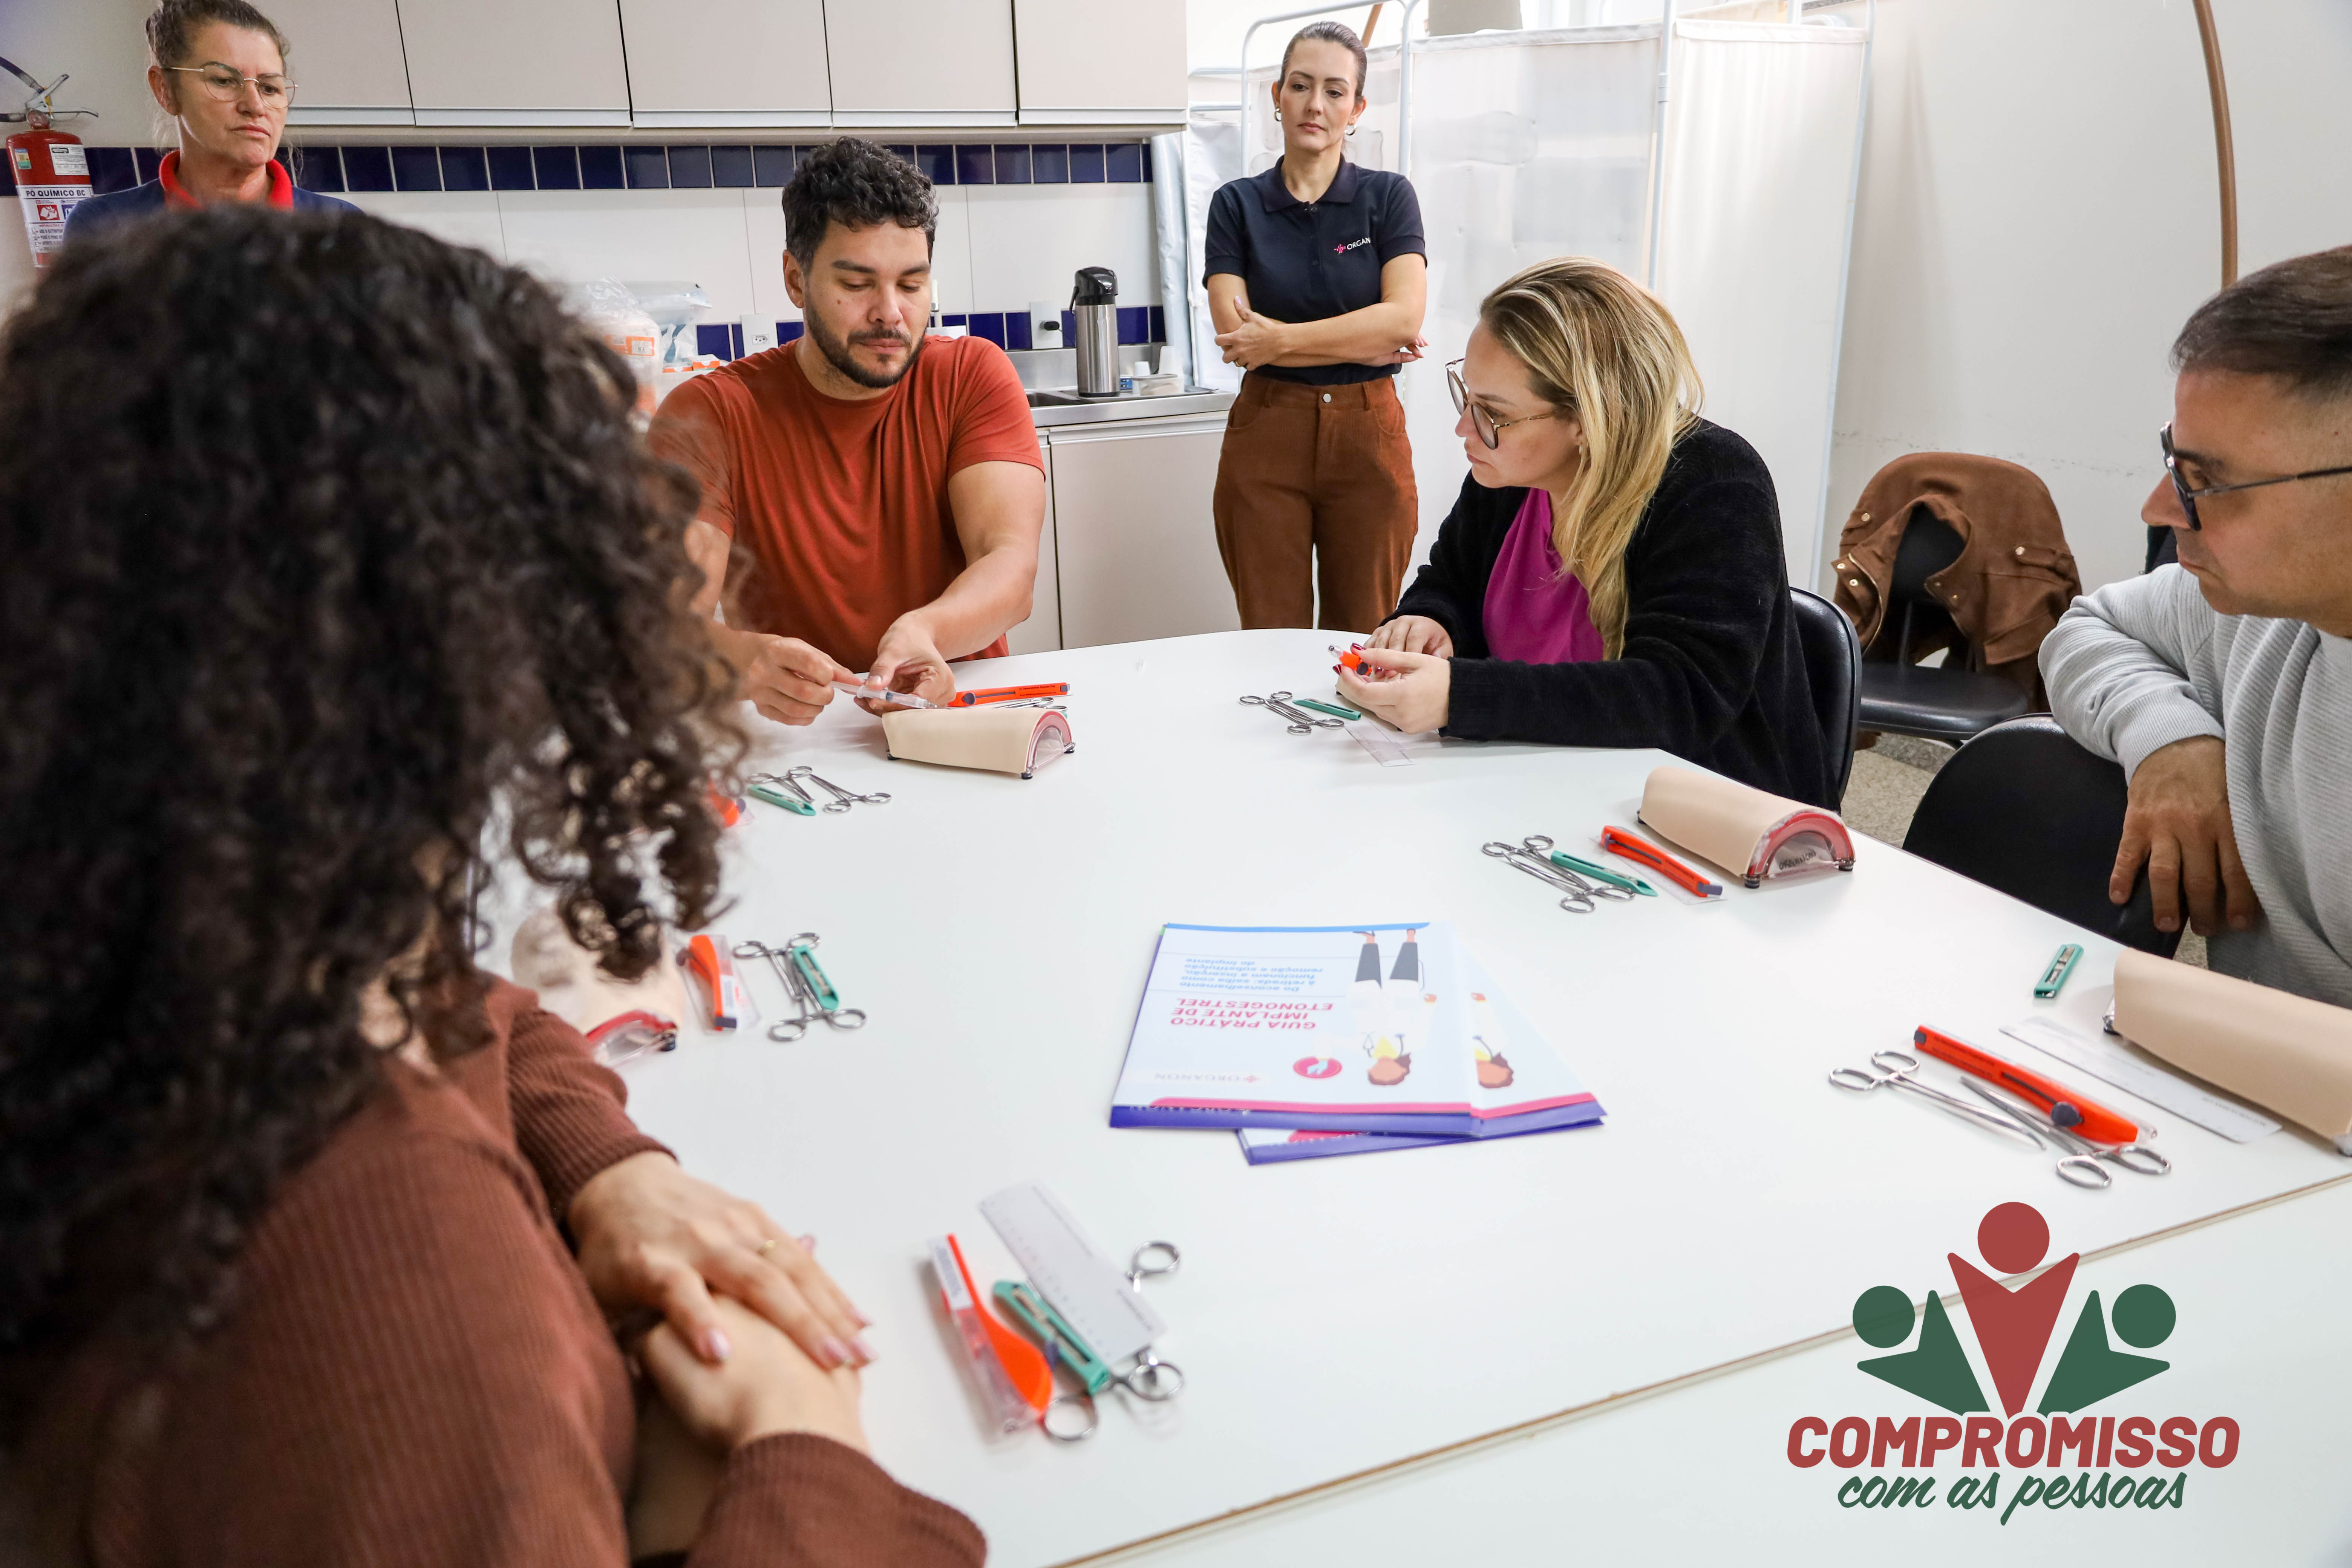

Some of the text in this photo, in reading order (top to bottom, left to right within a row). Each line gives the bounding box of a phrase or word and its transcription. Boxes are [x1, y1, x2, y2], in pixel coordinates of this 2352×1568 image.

[1179, 982, 1280, 990] aconselhamento
[1177, 998, 1334, 1010] ETONOGESTREL
[1170, 1007, 1308, 1019] IMPLANTE DE
[1170, 1017, 1261, 1029] PRÁTICO
